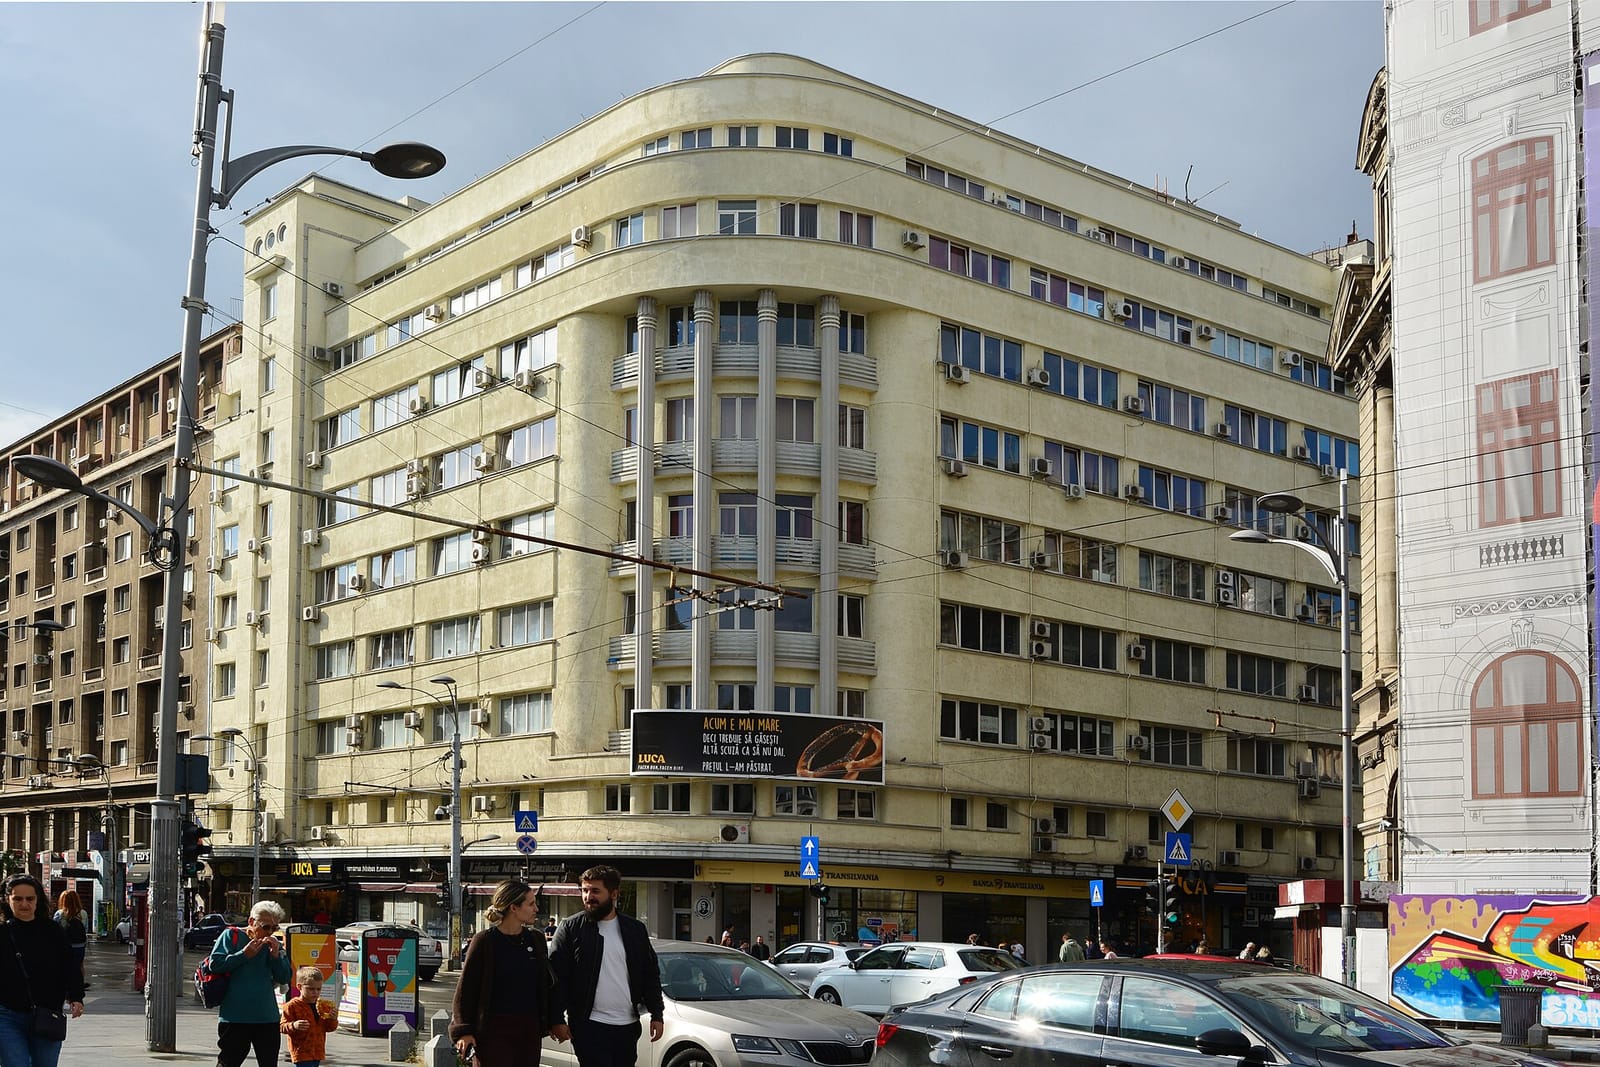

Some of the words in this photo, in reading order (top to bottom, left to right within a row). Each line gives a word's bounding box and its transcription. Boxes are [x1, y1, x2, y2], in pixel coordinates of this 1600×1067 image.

[703, 717, 727, 731] ACUM
[730, 718, 735, 731] E
[738, 718, 755, 731] MAI
[702, 733, 716, 743] DECI
[718, 733, 742, 744] TREBUIE
[744, 732, 752, 744] SĂ
[702, 743, 718, 755] ALTĂ
[720, 743, 739, 755] SCUZĂ
[741, 746, 750, 756] CA
[752, 744, 760, 756] SĂ
[762, 747, 772, 756] NU
[773, 747, 786, 757] DAI.
[638, 753, 666, 764] LUCA
[133, 852, 150, 861] TED'S
[291, 862, 313, 876] LUCA
[825, 872, 880, 881] TRANSILVANIA
